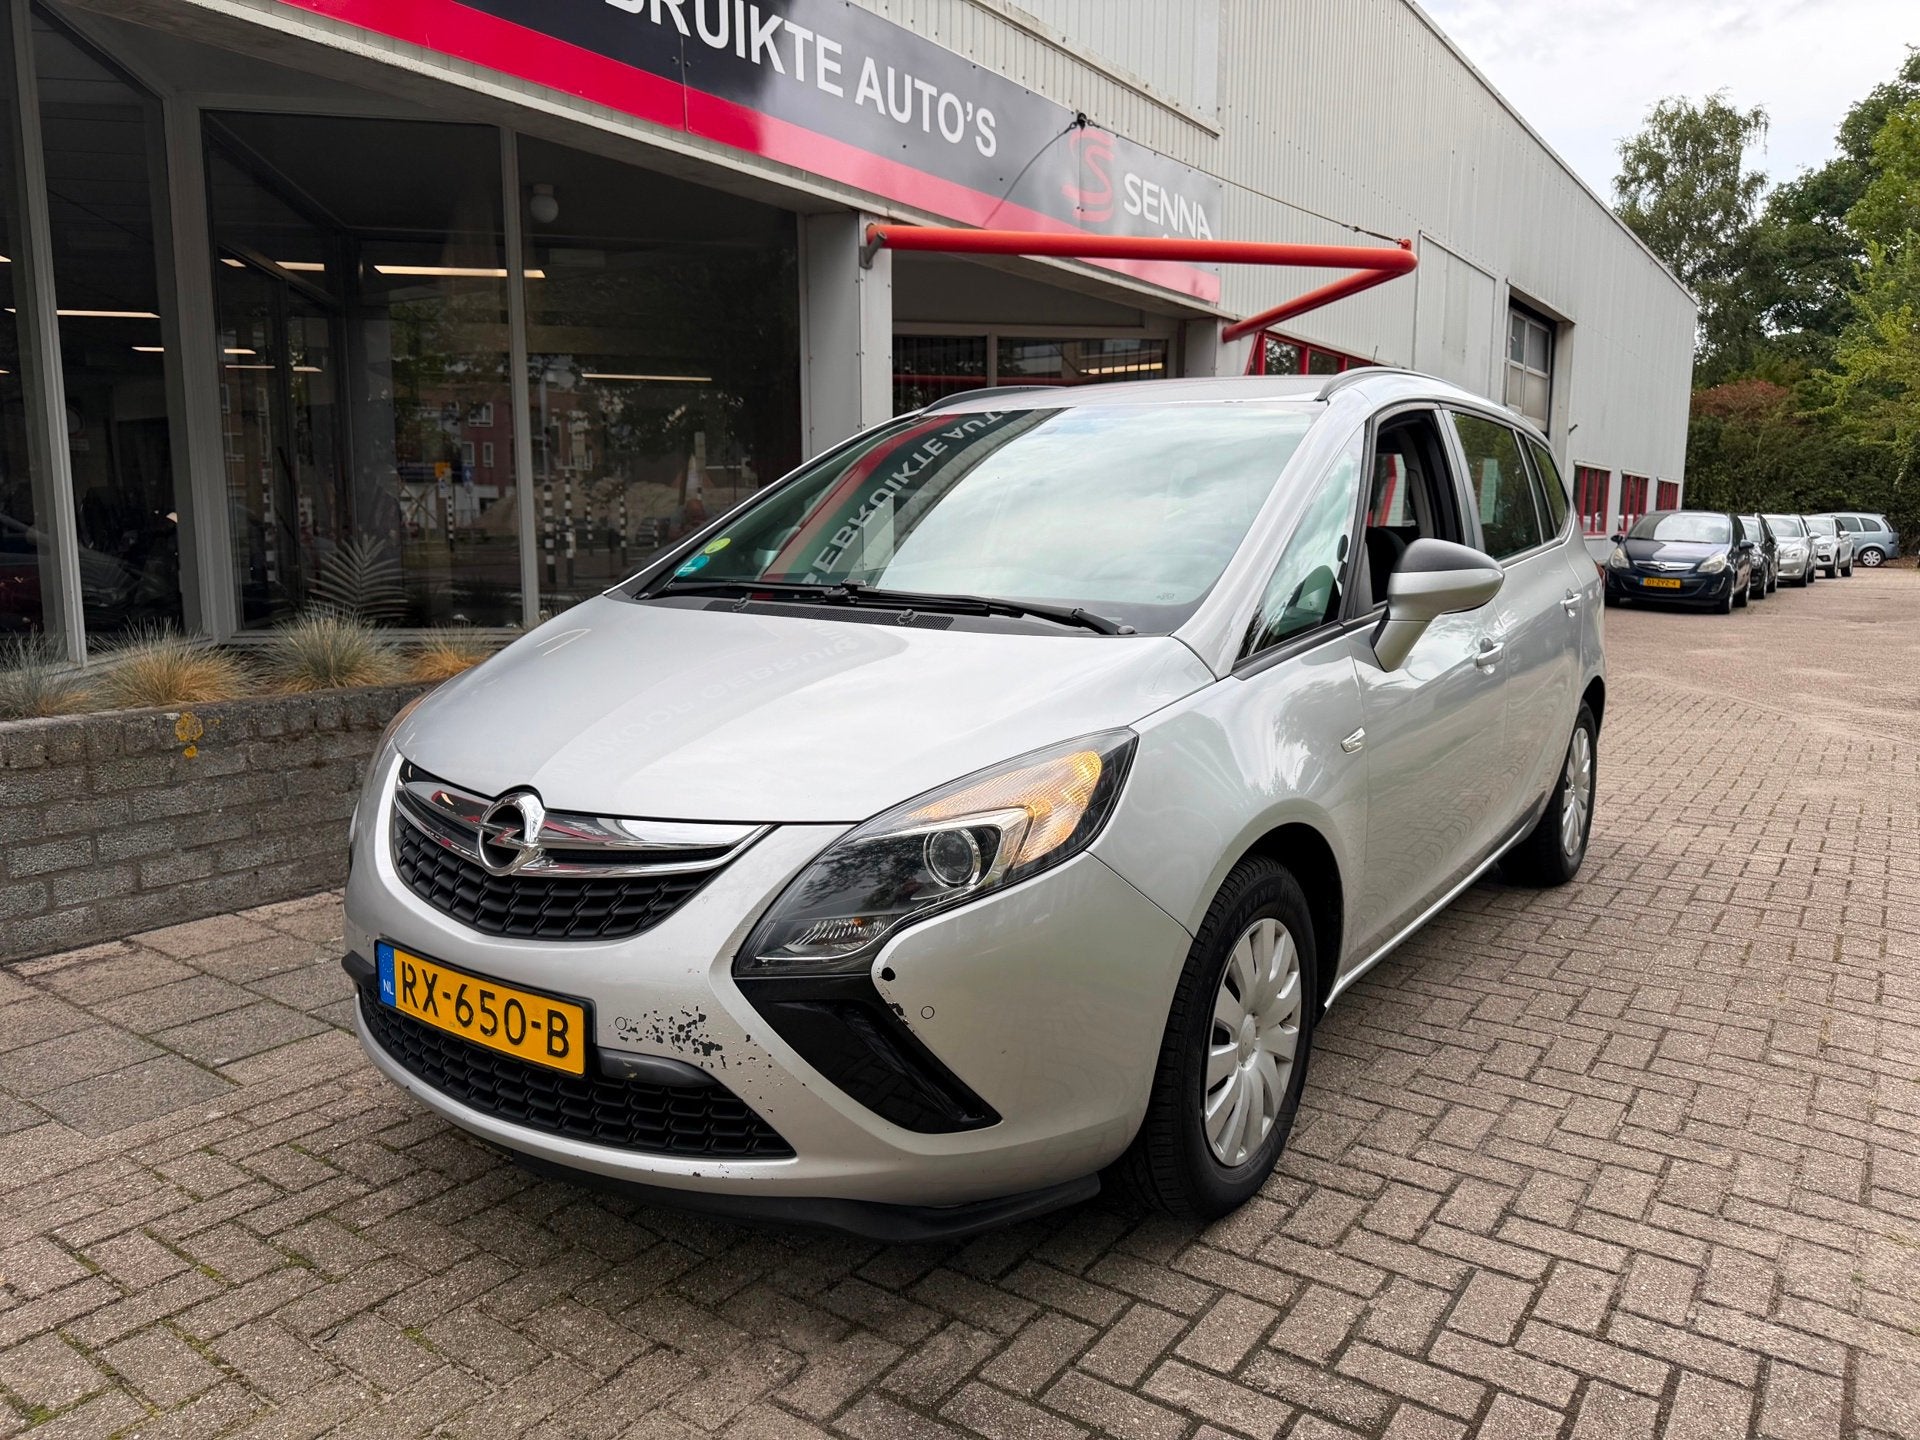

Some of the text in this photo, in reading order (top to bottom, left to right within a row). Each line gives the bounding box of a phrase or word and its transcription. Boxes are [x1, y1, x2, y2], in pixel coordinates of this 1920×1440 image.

[854, 56, 998, 158] AUTO'S
[1123, 172, 1213, 241] SENNA
[383, 978, 395, 995] NL
[401, 960, 570, 1058] RX-650-B
